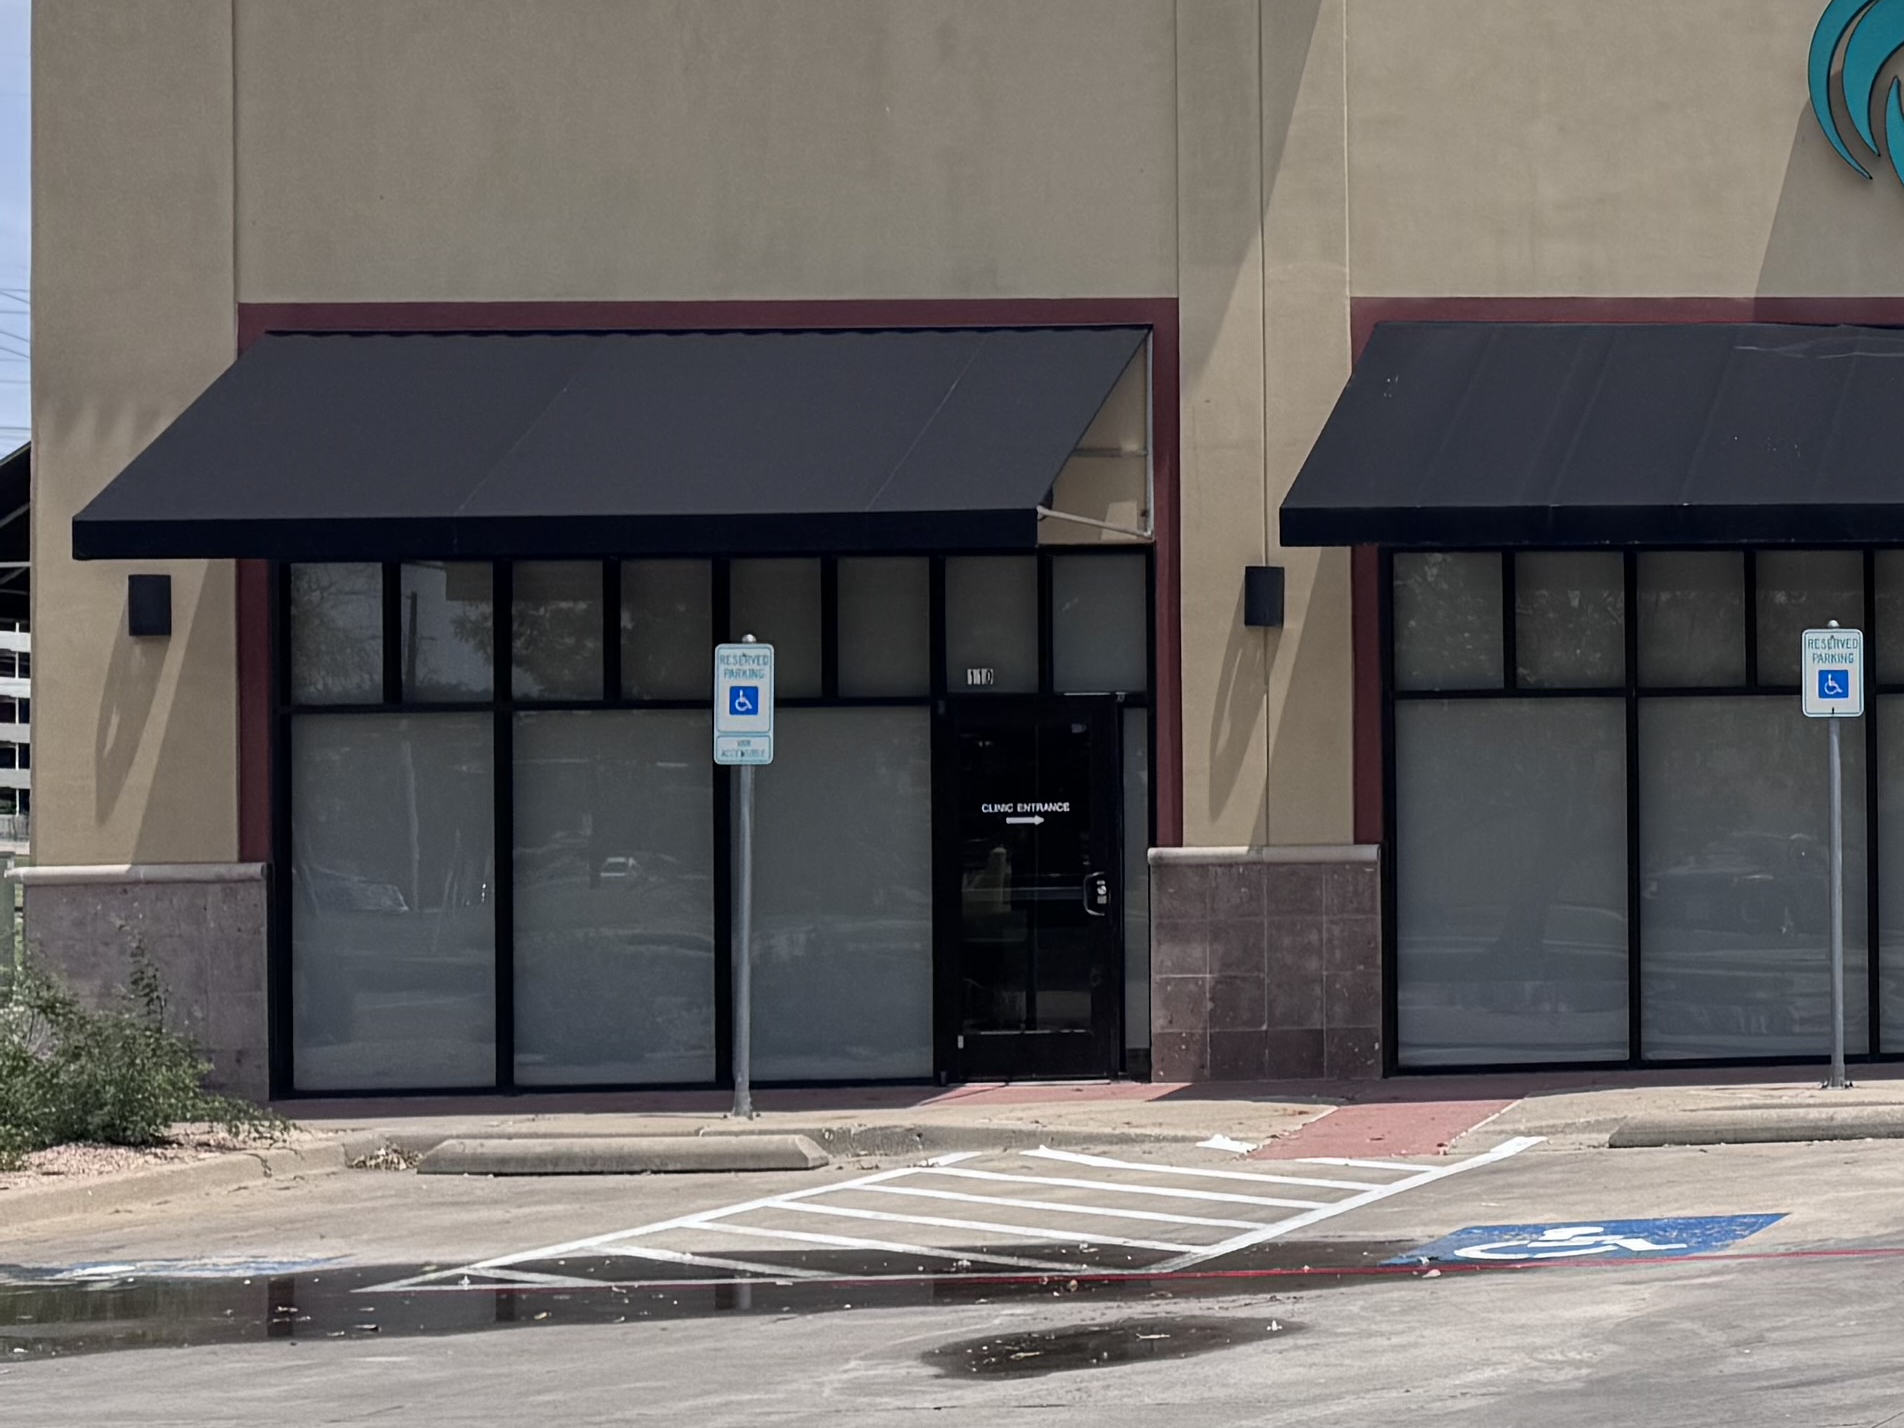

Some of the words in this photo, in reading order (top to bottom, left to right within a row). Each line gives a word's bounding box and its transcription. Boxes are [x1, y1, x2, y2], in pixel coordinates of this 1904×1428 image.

[1807, 638, 1858, 650] RESERVED
[719, 654, 769, 666] RESERVED
[1812, 652, 1854, 664] PARKING
[723, 668, 765, 680] PARKING
[981, 803, 1013, 813] CLINIC
[1017, 802, 1070, 812] ENTRANCE
